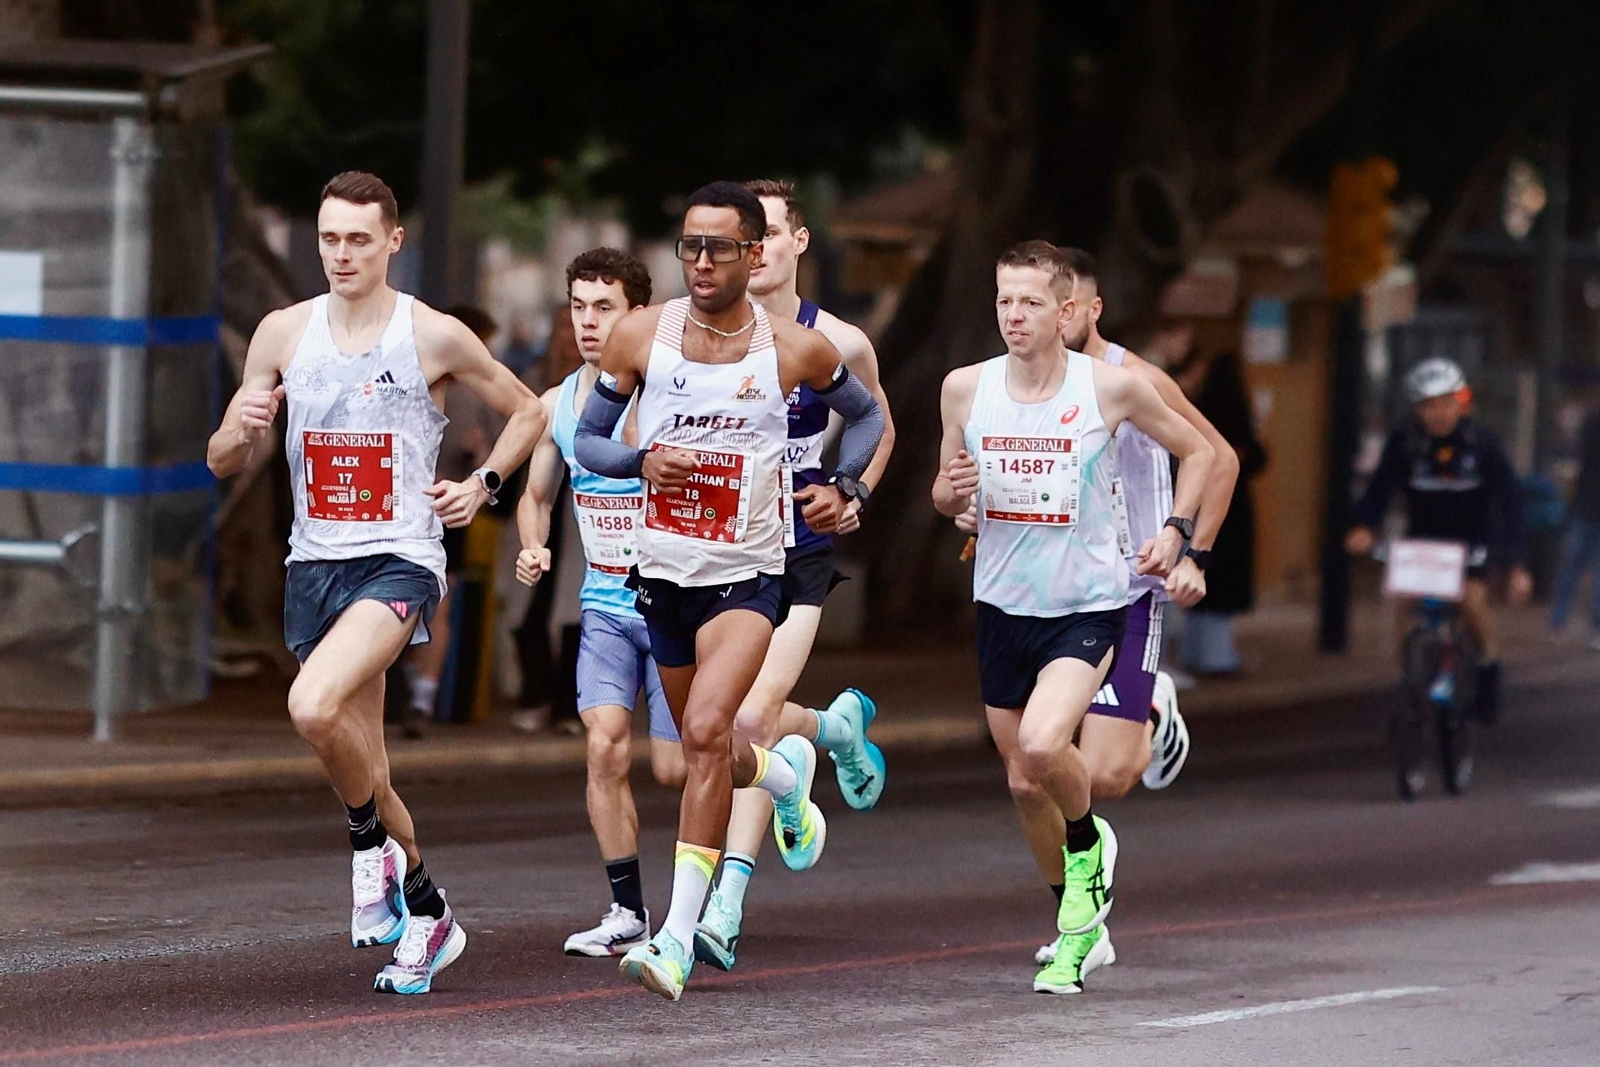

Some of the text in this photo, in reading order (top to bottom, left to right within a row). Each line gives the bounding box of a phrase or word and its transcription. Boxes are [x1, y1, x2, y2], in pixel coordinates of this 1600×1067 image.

[376, 386, 407, 396] MARTIN
[673, 413, 748, 430] TARGET
[323, 434, 386, 447] GENERALI
[1005, 439, 1066, 452] GENERALI
[331, 456, 360, 467] ALEX
[697, 452, 738, 468] ERALI
[999, 458, 1055, 475] 14587
[338, 473, 353, 485] 17
[686, 472, 725, 487] ATHAN
[684, 488, 700, 500] 18
[590, 497, 639, 510] GENERALI
[589, 514, 633, 531] 14588
